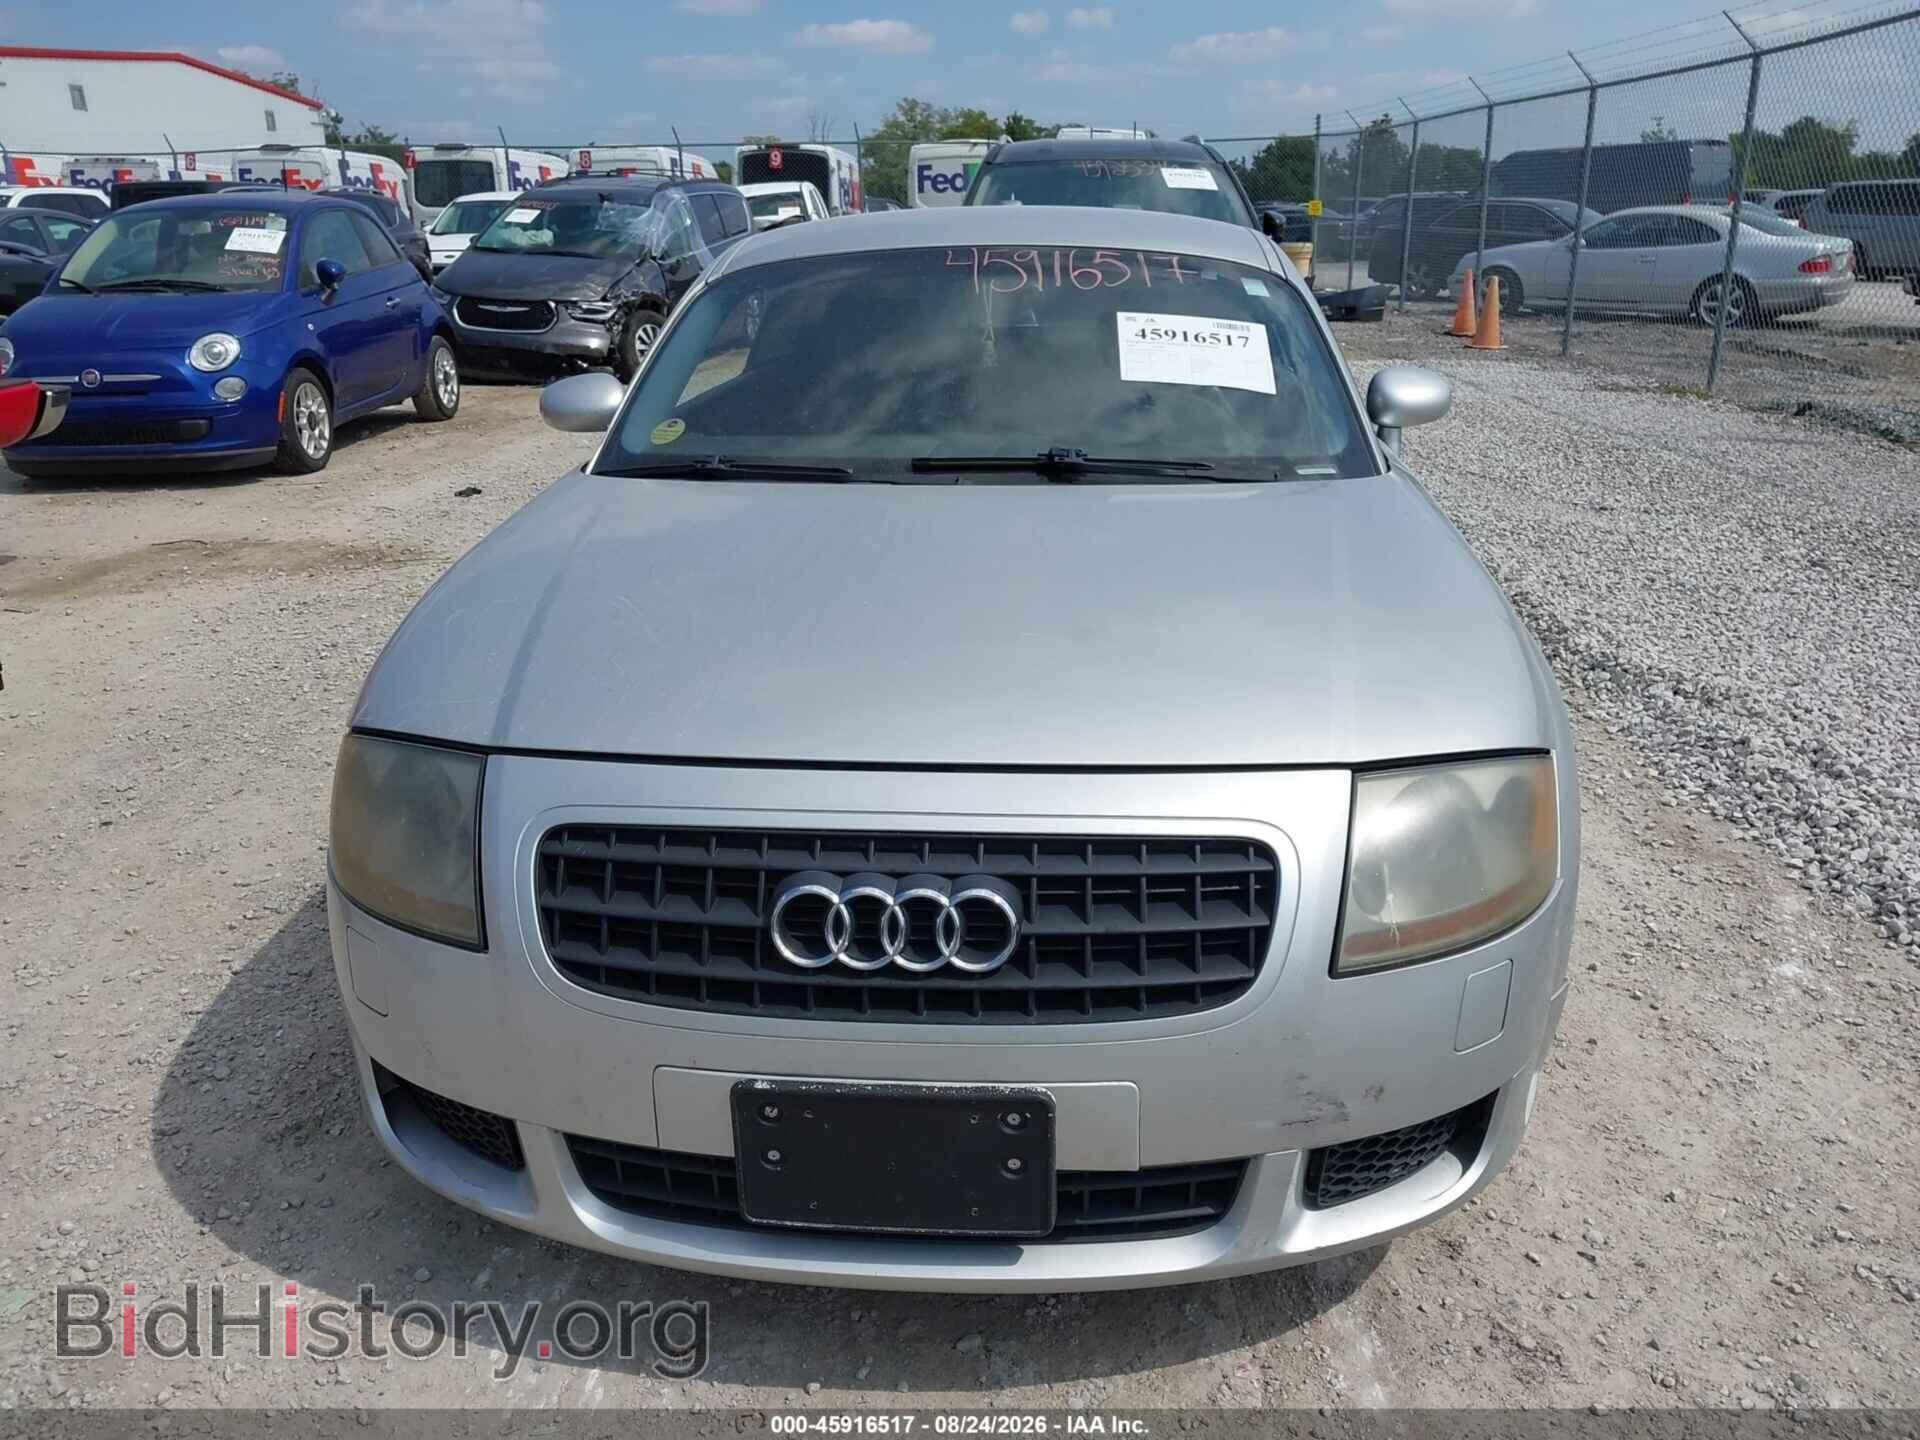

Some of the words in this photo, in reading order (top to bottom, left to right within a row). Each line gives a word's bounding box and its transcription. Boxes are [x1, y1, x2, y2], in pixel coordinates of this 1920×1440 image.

[770, 150, 781, 167] 9
[946, 247, 1199, 296] 45916517
[1135, 327, 1251, 349] 45916517
